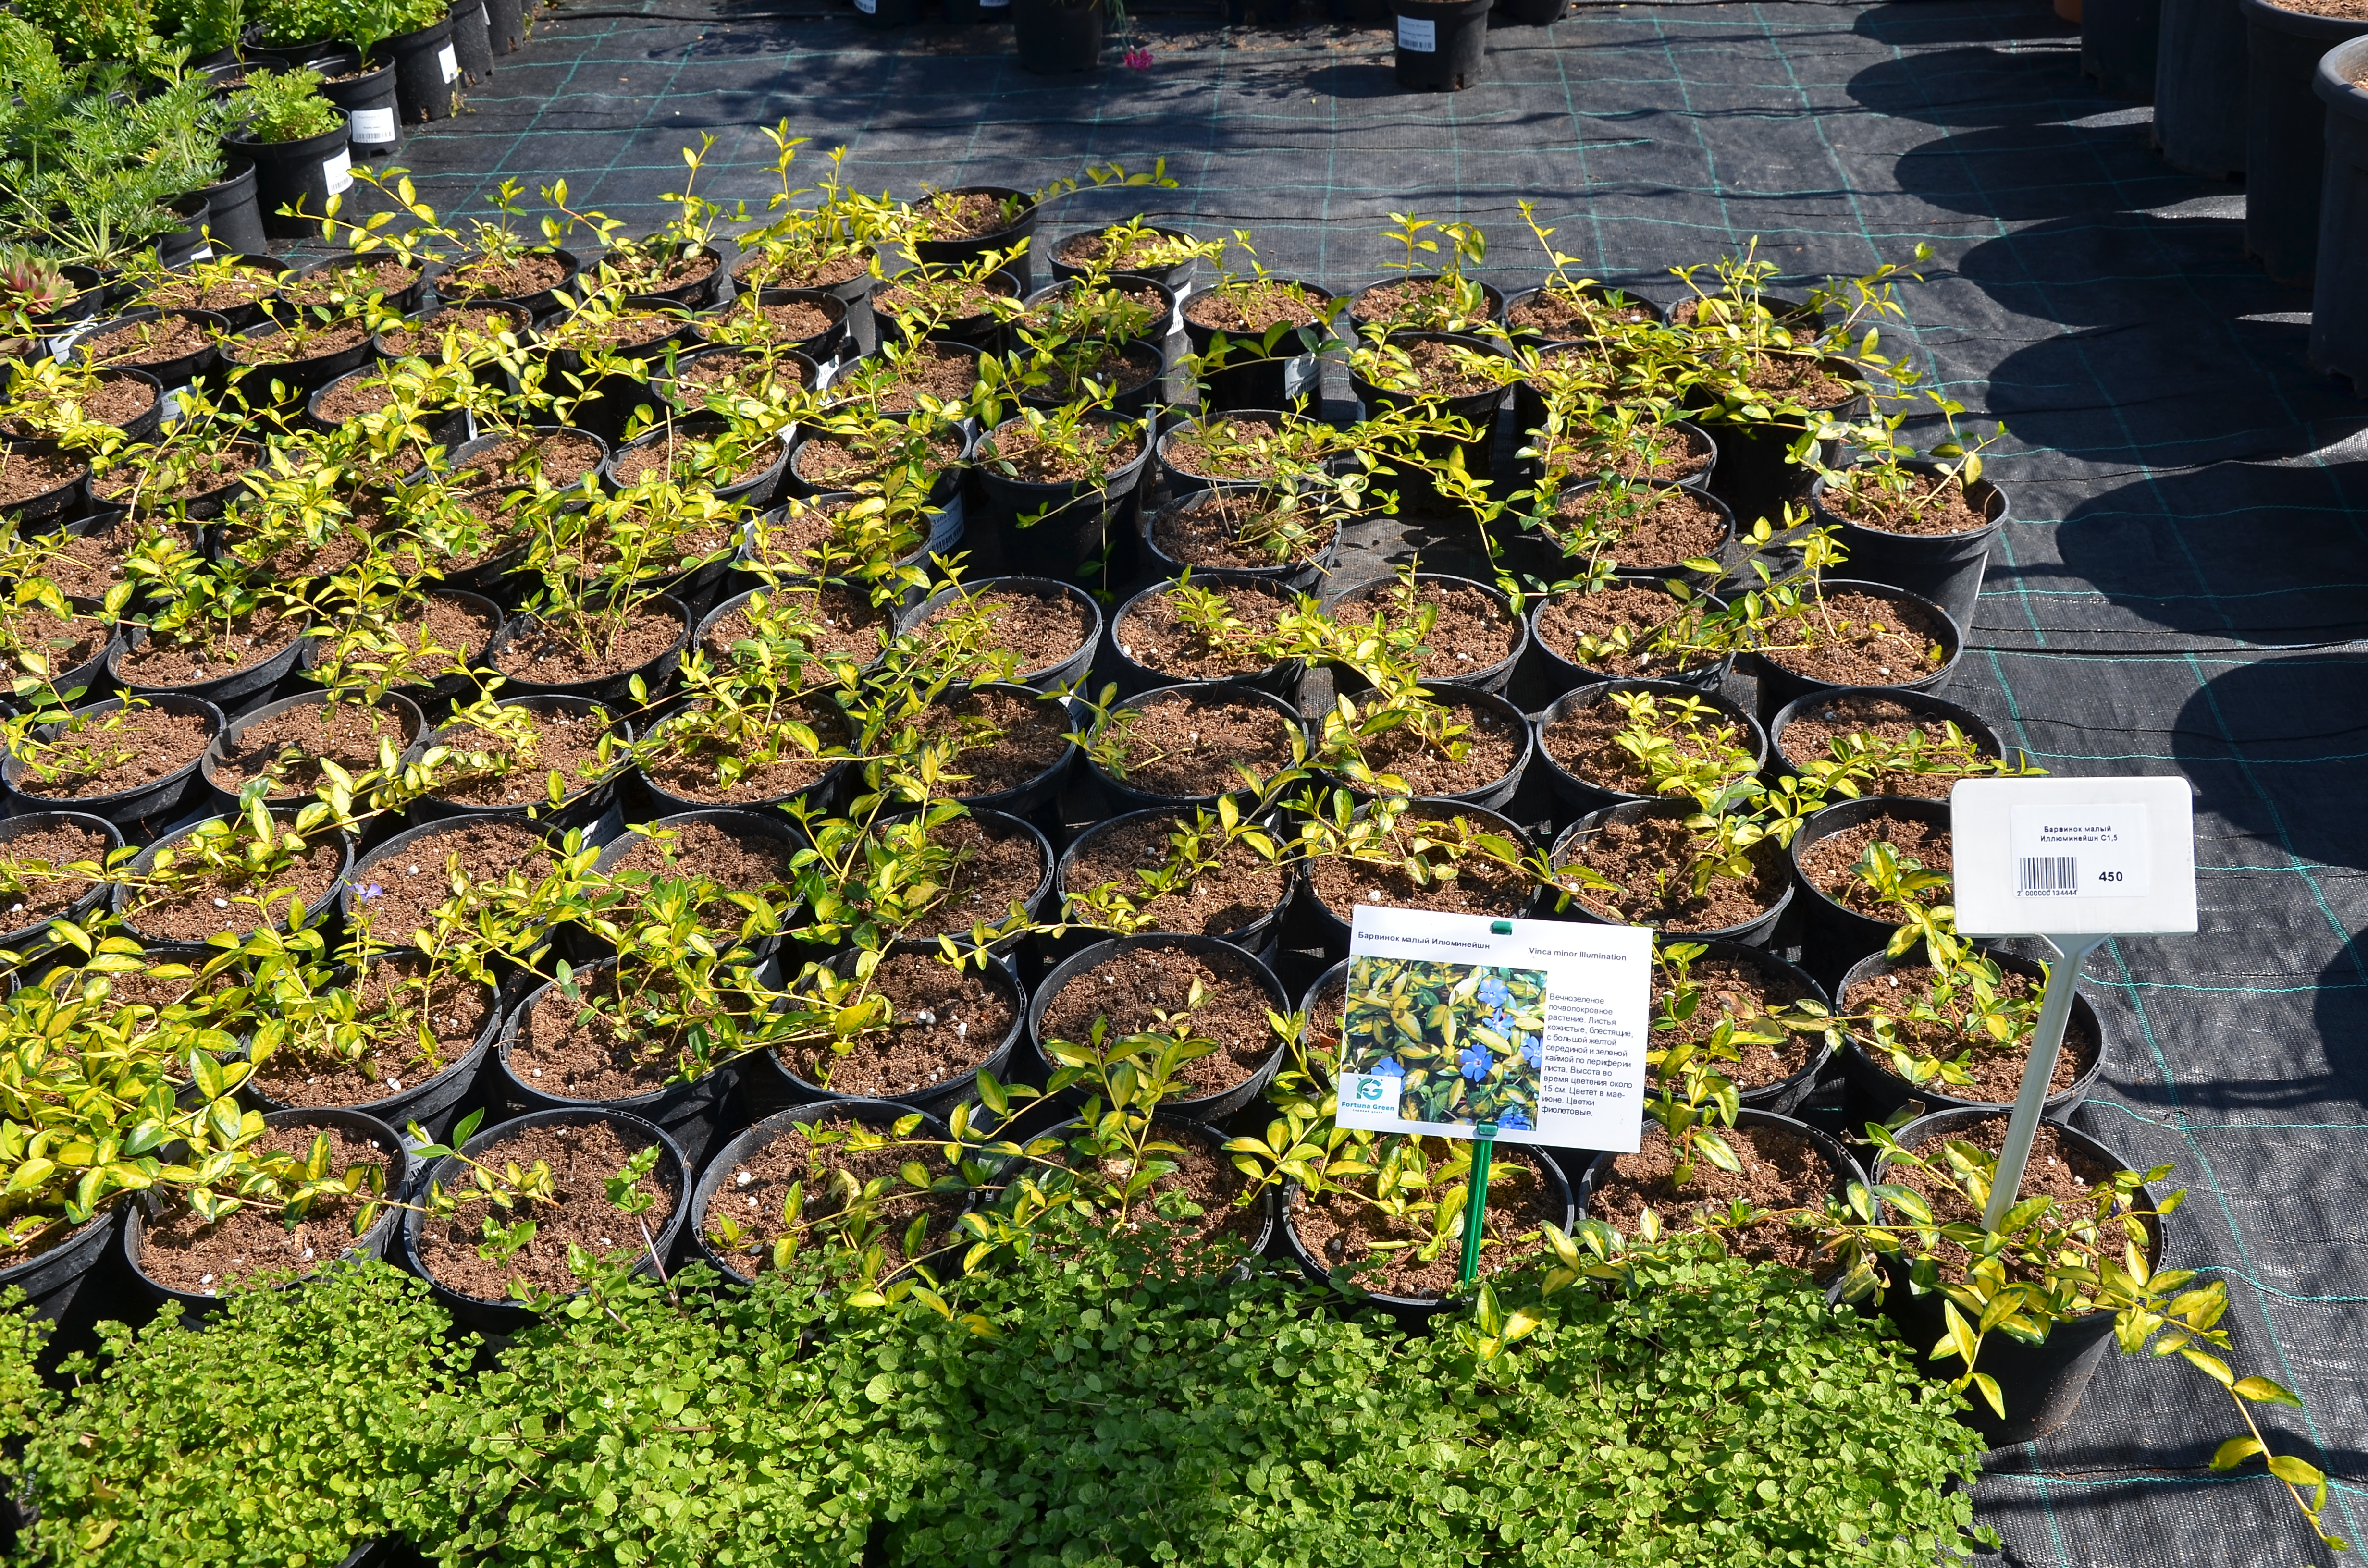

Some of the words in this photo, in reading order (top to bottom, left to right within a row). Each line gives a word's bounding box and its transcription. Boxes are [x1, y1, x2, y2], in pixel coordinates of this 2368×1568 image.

[2044, 825, 2082, 834] Барвинок
[2099, 871, 2123, 882] 450
[1358, 931, 1399, 942] Барвинок
[1402, 936, 1430, 944] малый
[1432, 938, 1490, 949] Илюминейшн
[1579, 951, 1626, 961] Illumination
[1549, 993, 1604, 1004] Вечнозеленое
[1549, 1004, 1613, 1015] почвопокровное
[1548, 1015, 1586, 1023] растение.
[1589, 1017, 1616, 1025] Листья
[1547, 1025, 1587, 1034] кожистые,
[1589, 1027, 1633, 1038] блестящие,
[1553, 1034, 1587, 1043] большой
[1546, 1045, 1587, 1054] серединой
[1587, 1058, 1631, 1068] периферии
[1570, 1066, 1600, 1075] Высота
[1571, 1078, 1607, 1086] цветения
[1569, 1087, 1597, 1096] Цветет
[1566, 1097, 1594, 1106] Цветки
[1541, 1105, 1593, 1116] фиолетовые.
